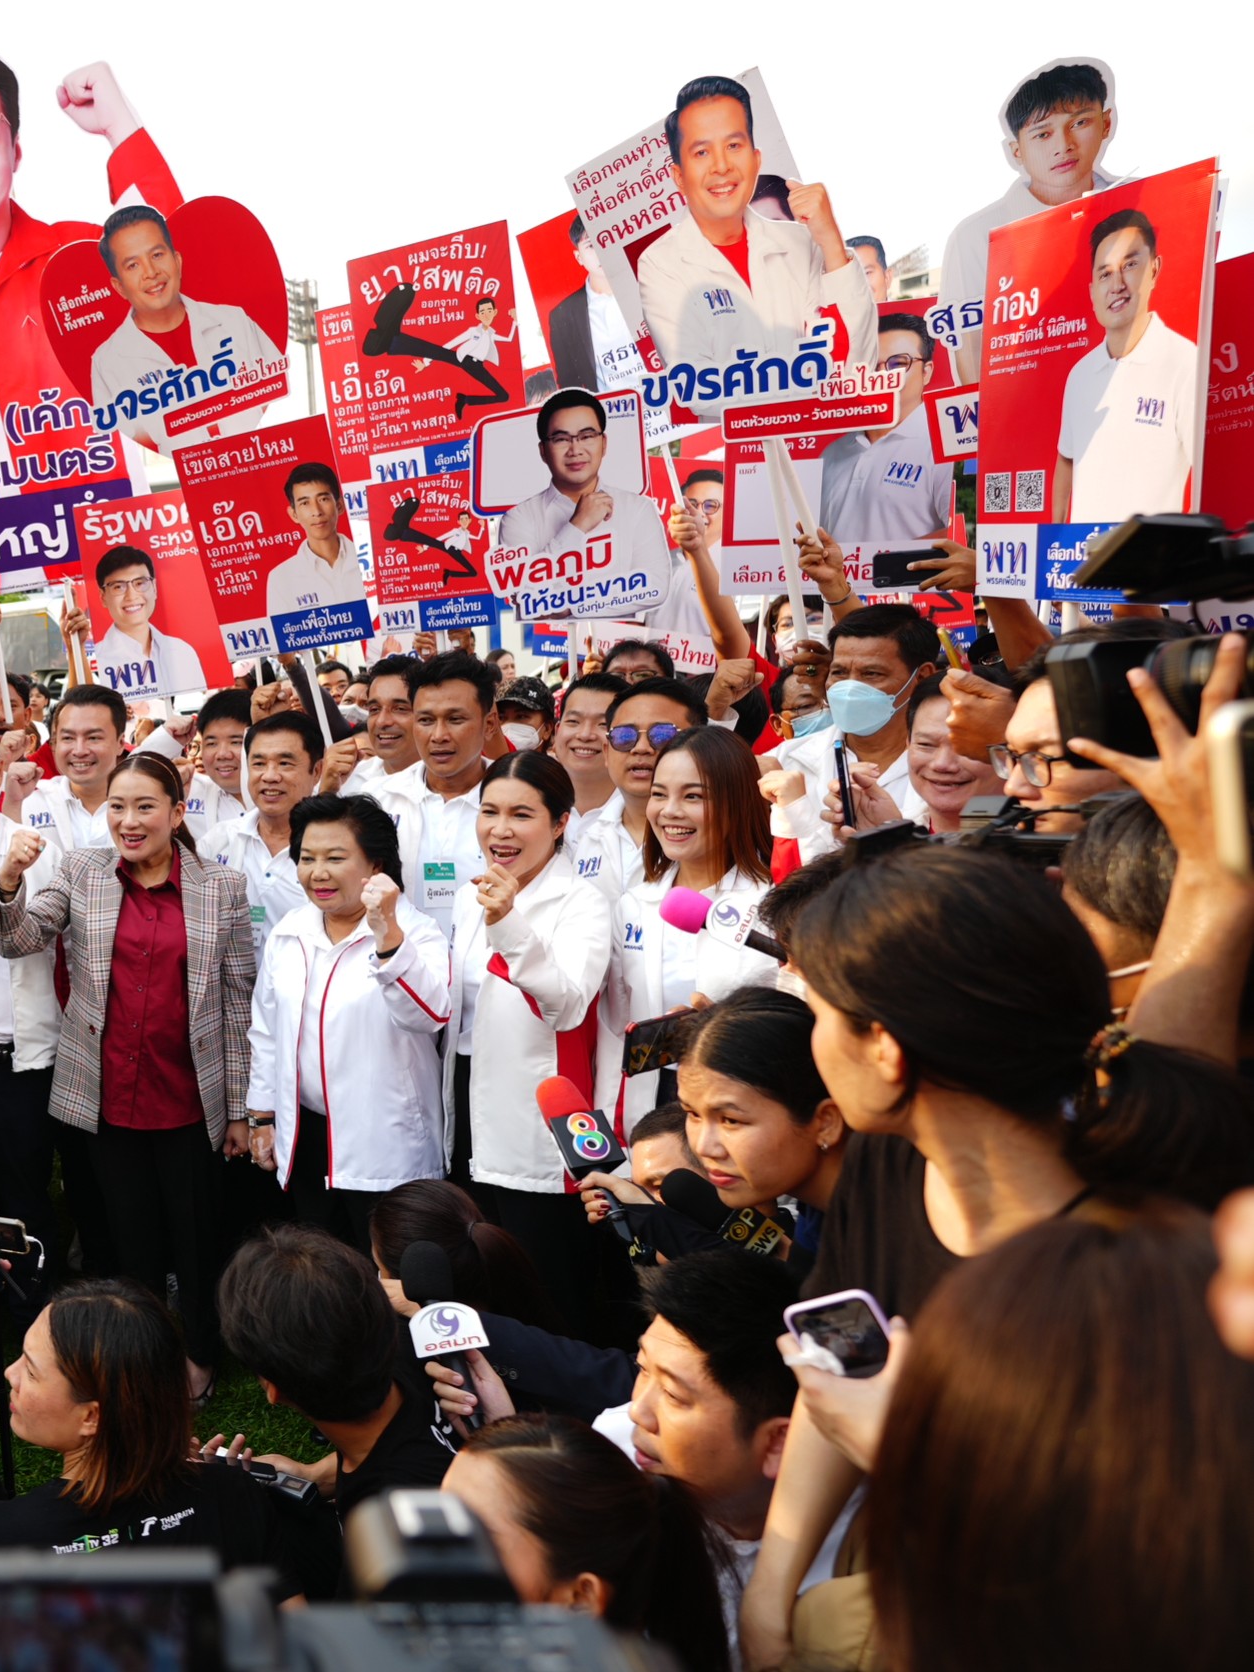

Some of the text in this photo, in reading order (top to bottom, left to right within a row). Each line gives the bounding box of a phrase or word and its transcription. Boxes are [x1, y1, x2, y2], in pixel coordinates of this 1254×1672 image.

[572, 131, 669, 195] เลือกคนทำง
[408, 235, 487, 266] ผมจะถีบ!
[359, 265, 500, 305] ยาเสพติด
[56, 284, 111, 313] เลือกทั้งคน
[421, 297, 458, 310] ออกจาก
[703, 288, 734, 310] พท
[992, 275, 1040, 325] ก้อง
[63, 310, 105, 332] ทั้งพรรค
[402, 307, 465, 327] เขตสายไหม
[1046, 315, 1087, 339] นิติพน
[642, 323, 901, 408] ขจรศักดิ์ เพื่อไทย
[93, 337, 289, 431] ขจรศักดิ์ เพื่อไทย
[330, 361, 362, 404] เอ๊
[365, 369, 406, 399] เอ๊ด
[170, 381, 283, 429] เขตห้วยขวาง วังทองหลาง
[367, 386, 451, 412] เอกภาพ หงสกุล
[606, 398, 635, 414] พท
[1137, 396, 1165, 420] พท
[6, 389, 91, 444] (เค้ก
[371, 413, 457, 439] ปวีณา หงสกุล
[730, 402, 888, 429] เขตห้วยขวาง วังทองหลาง
[338, 430, 368, 448] ปวีณ
[798, 437, 816, 450] 32
[183, 436, 295, 477] เขตสายไหม
[418, 476, 463, 490] ผมจะถีบ!
[887, 460, 922, 482] พท
[199, 500, 264, 545] เอ๊ด
[206, 530, 301, 559] เอกภาพ หงสกุล
[489, 546, 528, 566] เลือก
[210, 552, 261, 570] น้องชายคู่คิด
[378, 547, 408, 568] เอ๊ด
[412, 563, 440, 574] หงสกุล
[493, 533, 612, 591] พลภูมิ
[983, 540, 1027, 574] พท
[214, 569, 258, 588] ปวีณา
[733, 563, 773, 583] เลือก
[986, 575, 1026, 587] พรรคเพื่อไทย
[218, 583, 254, 596] หงสกุล
[381, 583, 409, 595] ปวีณา
[412, 580, 444, 593] หงสกุล
[521, 571, 647, 616] ให้ชนะขาด
[577, 588, 659, 616] บึงกุ่ม-คันนายาว
[282, 608, 353, 635] เลือกเพื่อไทย
[383, 609, 415, 627] พท
[427, 613, 489, 629] ทั้งคนทั้งพรรค
[227, 625, 270, 650] พท
[285, 624, 364, 649] ทั้งคนทั้งพรรค
[105, 660, 157, 690] พท
[427, 888, 454, 900] ผู้สมัคร
[566, 1111, 611, 1161] 8
[424, 1334, 482, 1352] อสมท
[160, 1507, 195, 1526] THAIRATH
[161, 1519, 182, 1530] ONLINE
[52, 1542, 84, 1555] ไทยรัฐ
[89, 1539, 99, 1549] TV
[101, 1533, 119, 1547] 32
